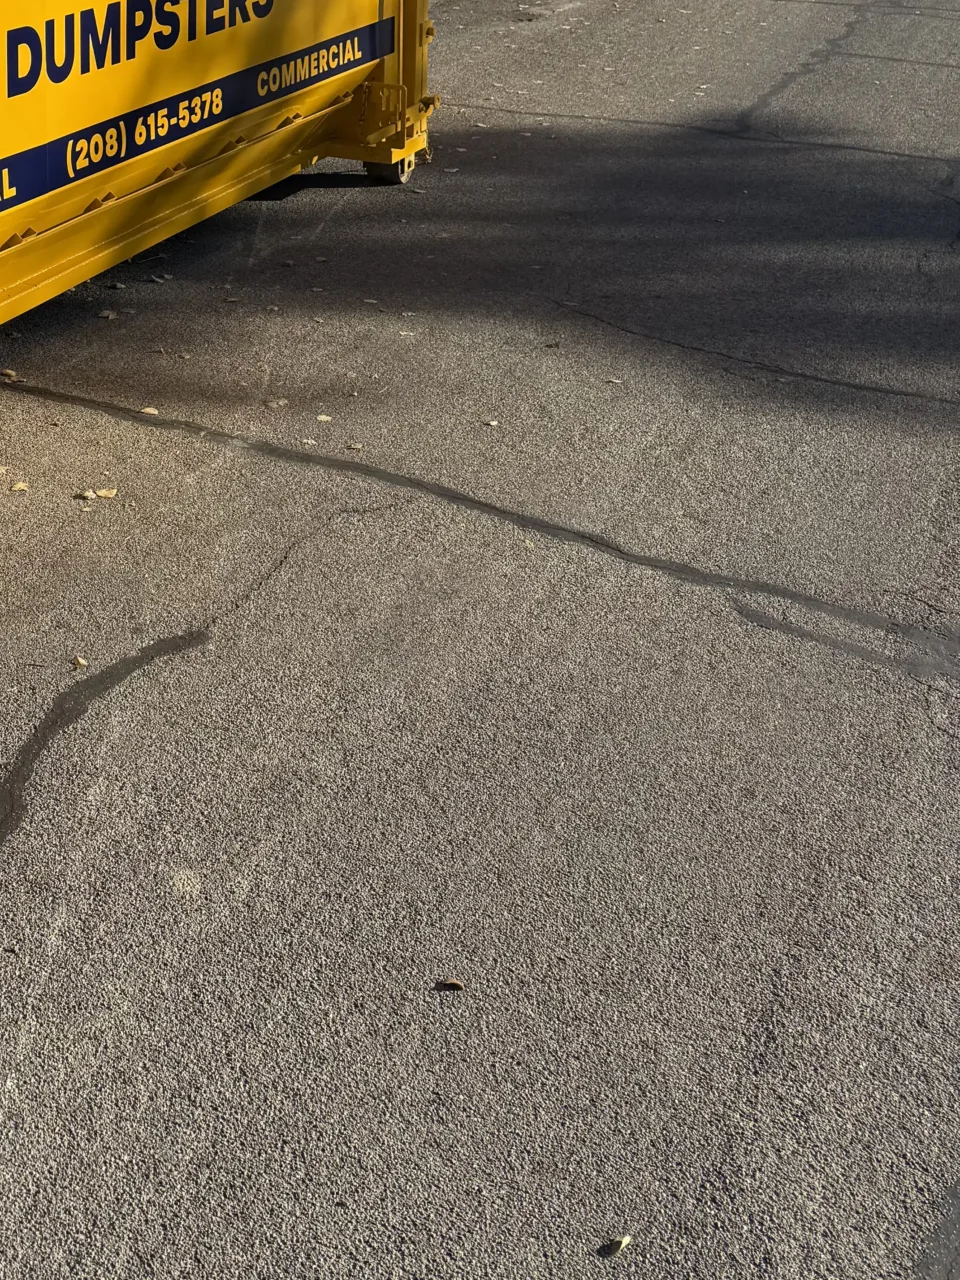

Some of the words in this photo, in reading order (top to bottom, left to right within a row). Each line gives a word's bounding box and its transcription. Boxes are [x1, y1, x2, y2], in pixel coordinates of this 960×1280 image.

[66, 122, 127, 178] (208)
[134, 87, 224, 146] 615-5378
[257, 36, 363, 97] COMMERCIAL
